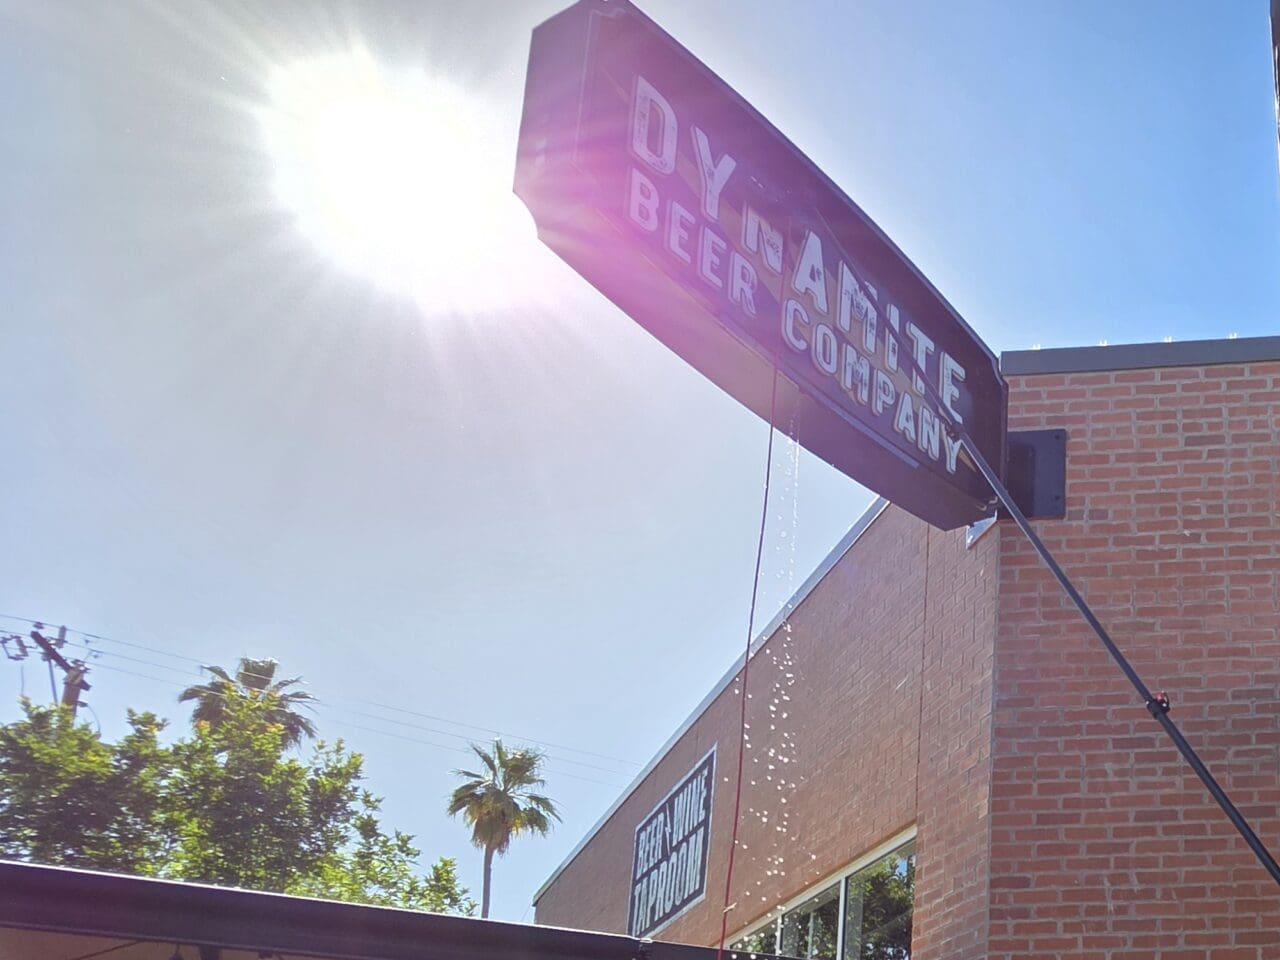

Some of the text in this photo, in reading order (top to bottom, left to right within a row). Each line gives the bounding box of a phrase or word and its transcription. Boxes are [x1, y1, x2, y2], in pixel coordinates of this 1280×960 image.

[628, 167, 965, 475] BEER COMPANY
[631, 75, 967, 424] DYNAMITE
[634, 828, 704, 936] TAPROOM
[636, 766, 708, 880] BEER WINE
